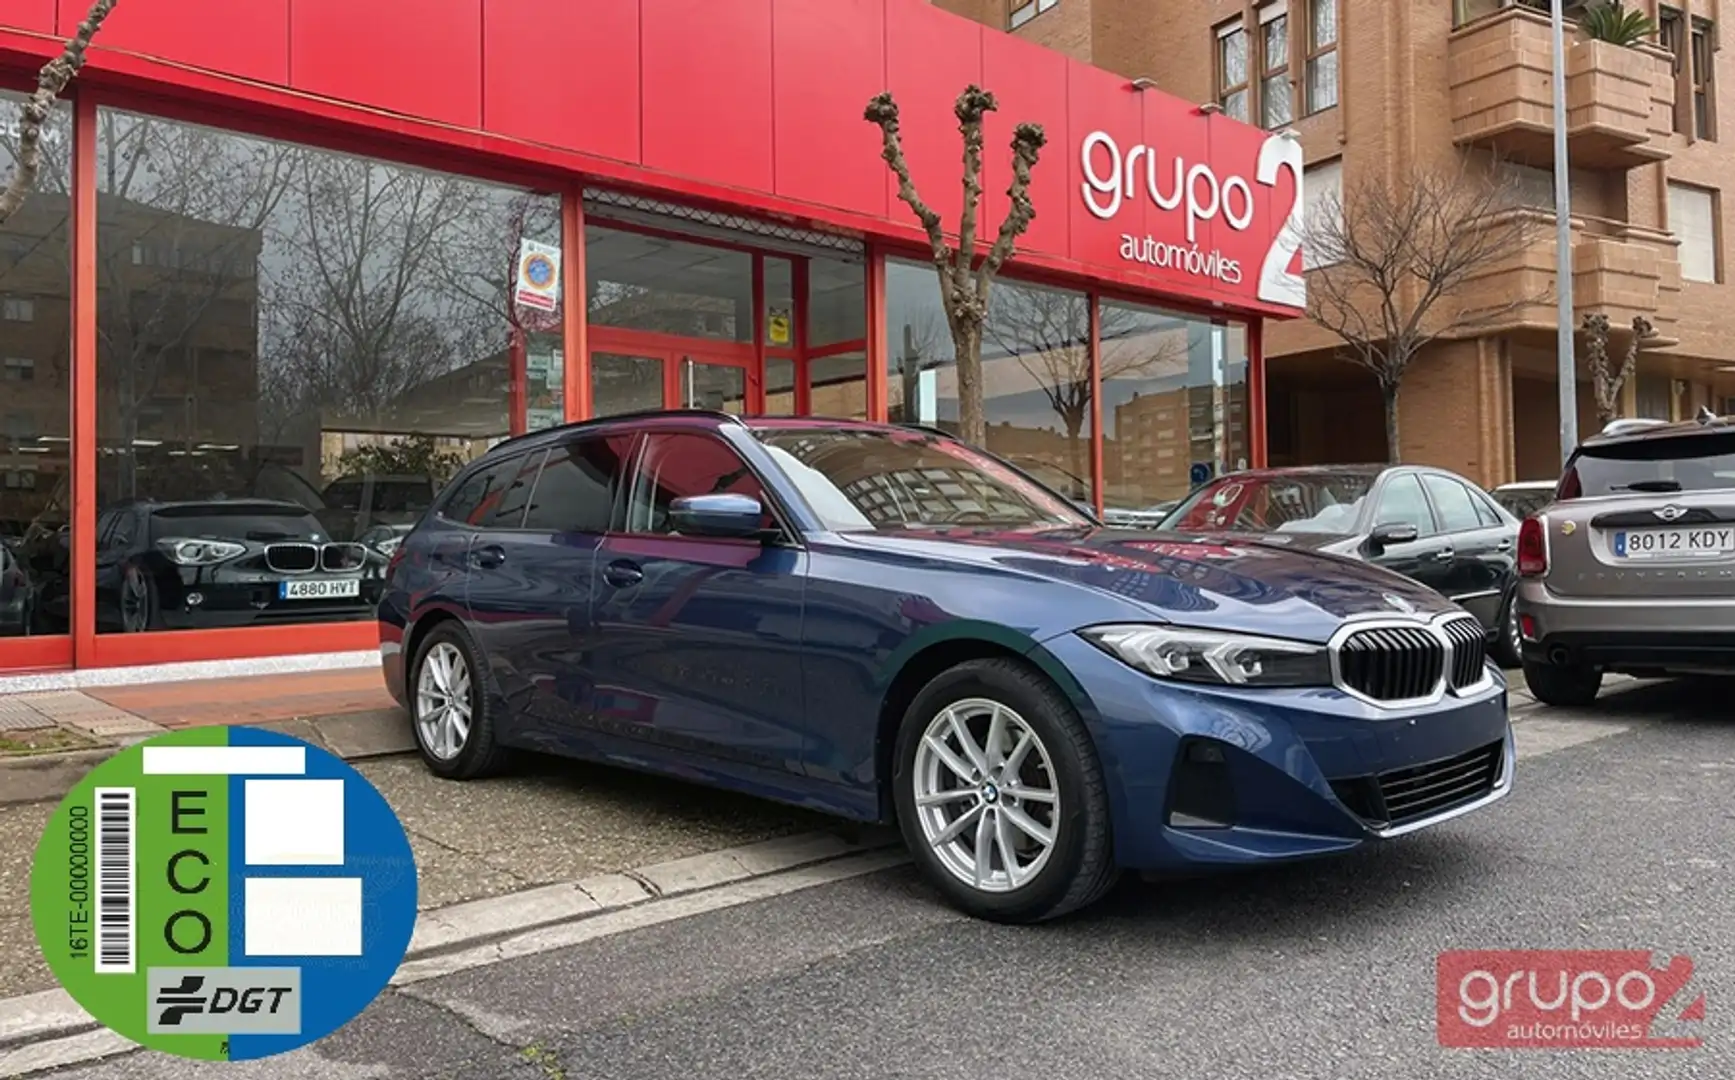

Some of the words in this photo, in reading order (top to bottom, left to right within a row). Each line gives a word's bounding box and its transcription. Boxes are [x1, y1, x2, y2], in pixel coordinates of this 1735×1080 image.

[1081, 131, 1254, 243] grupo
[1256, 133, 1306, 307] 2
[1119, 234, 1242, 283] automóviles
[1629, 532, 1681, 550] 8012
[1688, 530, 1729, 549] KDY
[289, 582, 327, 596] 4880
[329, 580, 356, 594] HVT
